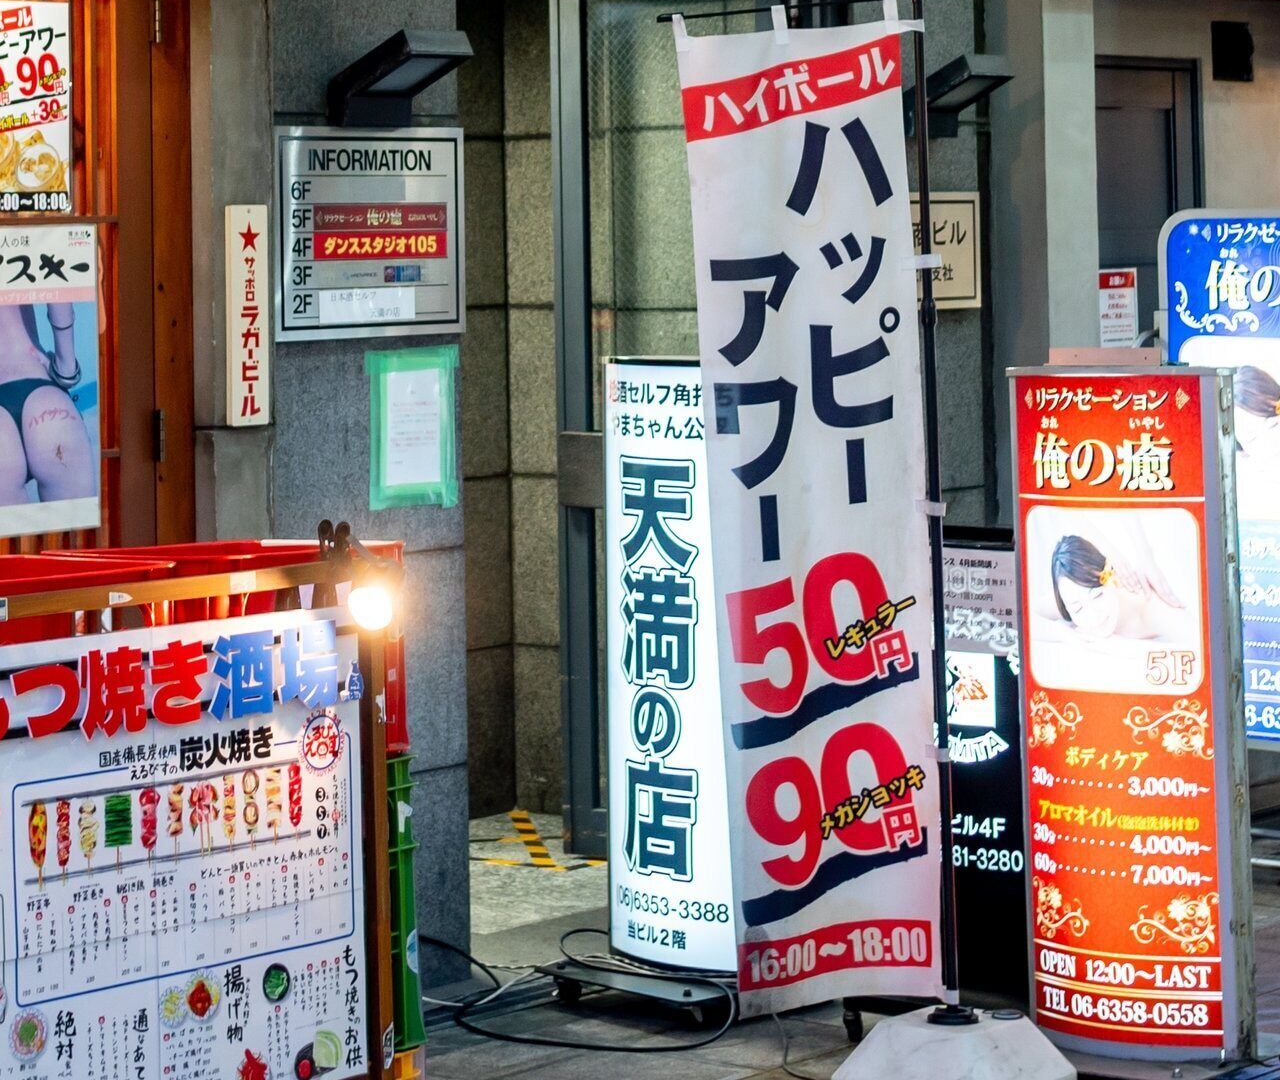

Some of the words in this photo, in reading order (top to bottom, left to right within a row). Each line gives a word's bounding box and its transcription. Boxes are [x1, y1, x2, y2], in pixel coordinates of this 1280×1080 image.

[703, 45, 897, 133] ハイボール
[307, 149, 432, 172] INFORMATION
[290, 180, 312, 201] 6F
[291, 207, 312, 229] 5F
[291, 235, 313, 257] 4F
[324, 235, 438, 255] ダンススタジオ105
[1219, 248, 1239, 260] おれ
[243, 256, 257, 303] サッポロ
[292, 265, 313, 286] 3F
[292, 293, 313, 315] 2F
[785, 115, 902, 506] ハッピー
[239, 306, 261, 418] ラガービール
[708, 251, 800, 563] アワー
[1035, 386, 1170, 412] リラクゼーション
[1041, 417, 1059, 429] おれ
[1128, 417, 1166, 431] いやし
[1033, 431, 1175, 492] 俺の癒
[823, 596, 917, 664] レギュラー
[619, 454, 699, 882] 天満の店
[1145, 650, 1194, 687] 5F
[178, 725, 274, 771] 炭火焼き
[1064, 745, 1150, 772] ボディケア
[821, 765, 927, 841] メガジョッキ
[616, 877, 730, 924] (06)6353-3388
[626, 921, 688, 951] 当ビル2階
[1039, 949, 1077, 978] OPEN
[223, 963, 246, 1046] 揚げ物
[341, 943, 365, 1071] もつ焼きのお供
[1043, 984, 1069, 1014] TEL
[1070, 992, 1209, 1027] 06-6358-0558
